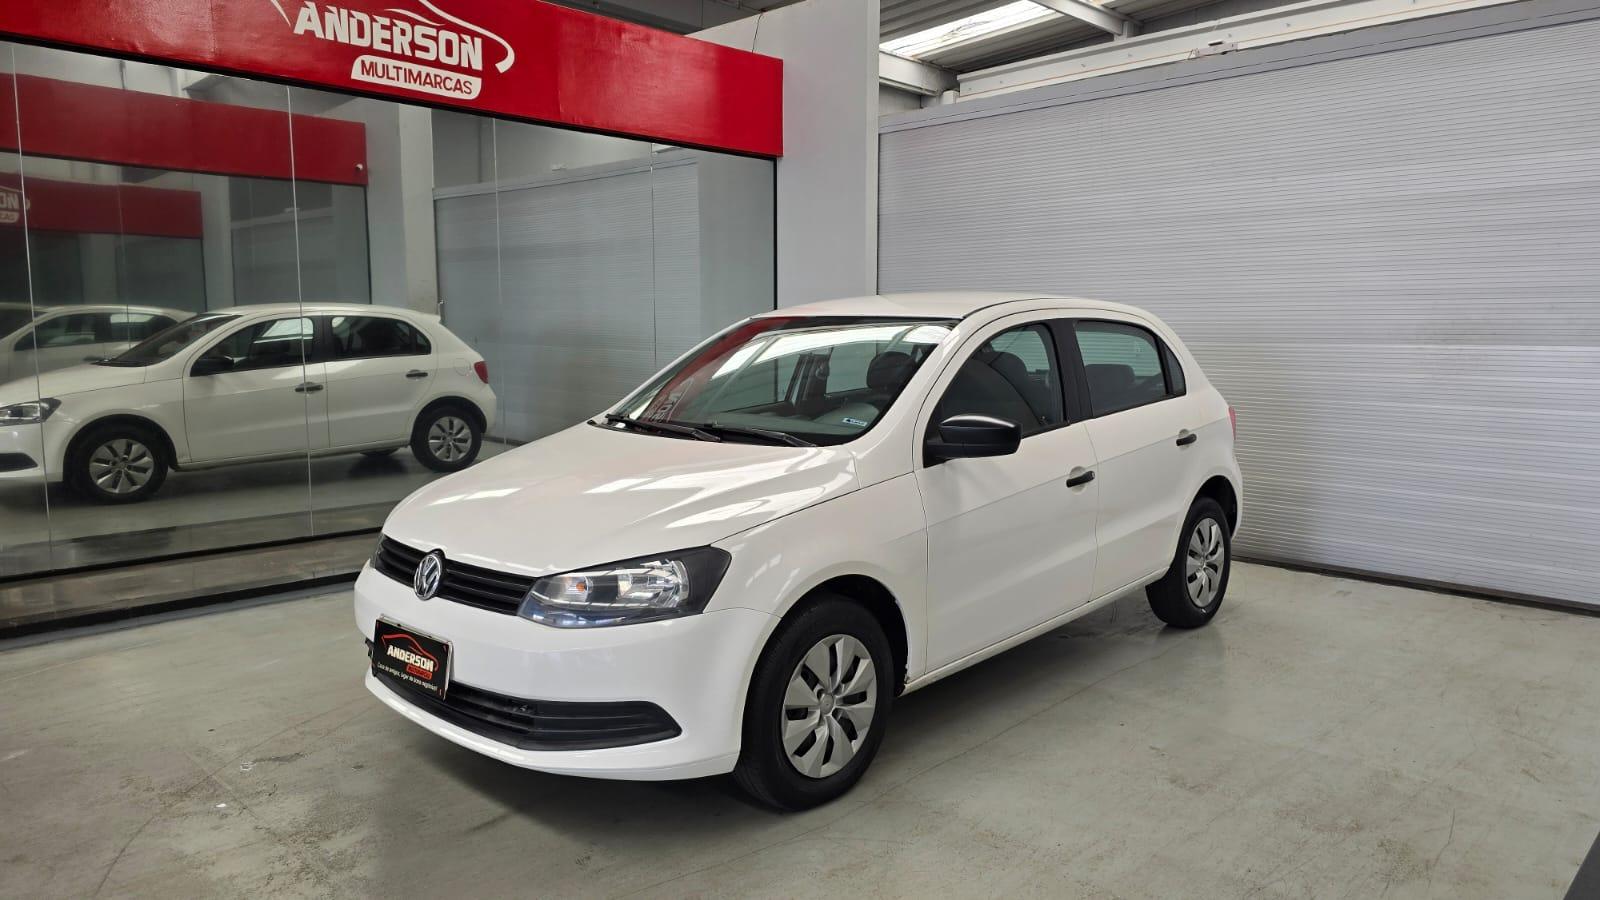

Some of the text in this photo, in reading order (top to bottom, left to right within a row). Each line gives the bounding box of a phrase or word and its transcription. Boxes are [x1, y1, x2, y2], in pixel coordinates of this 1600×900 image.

[293, 1, 483, 71] ANDERSON
[360, 59, 473, 95] MULTIMARCAS
[387, 644, 434, 672] ANDERSON
